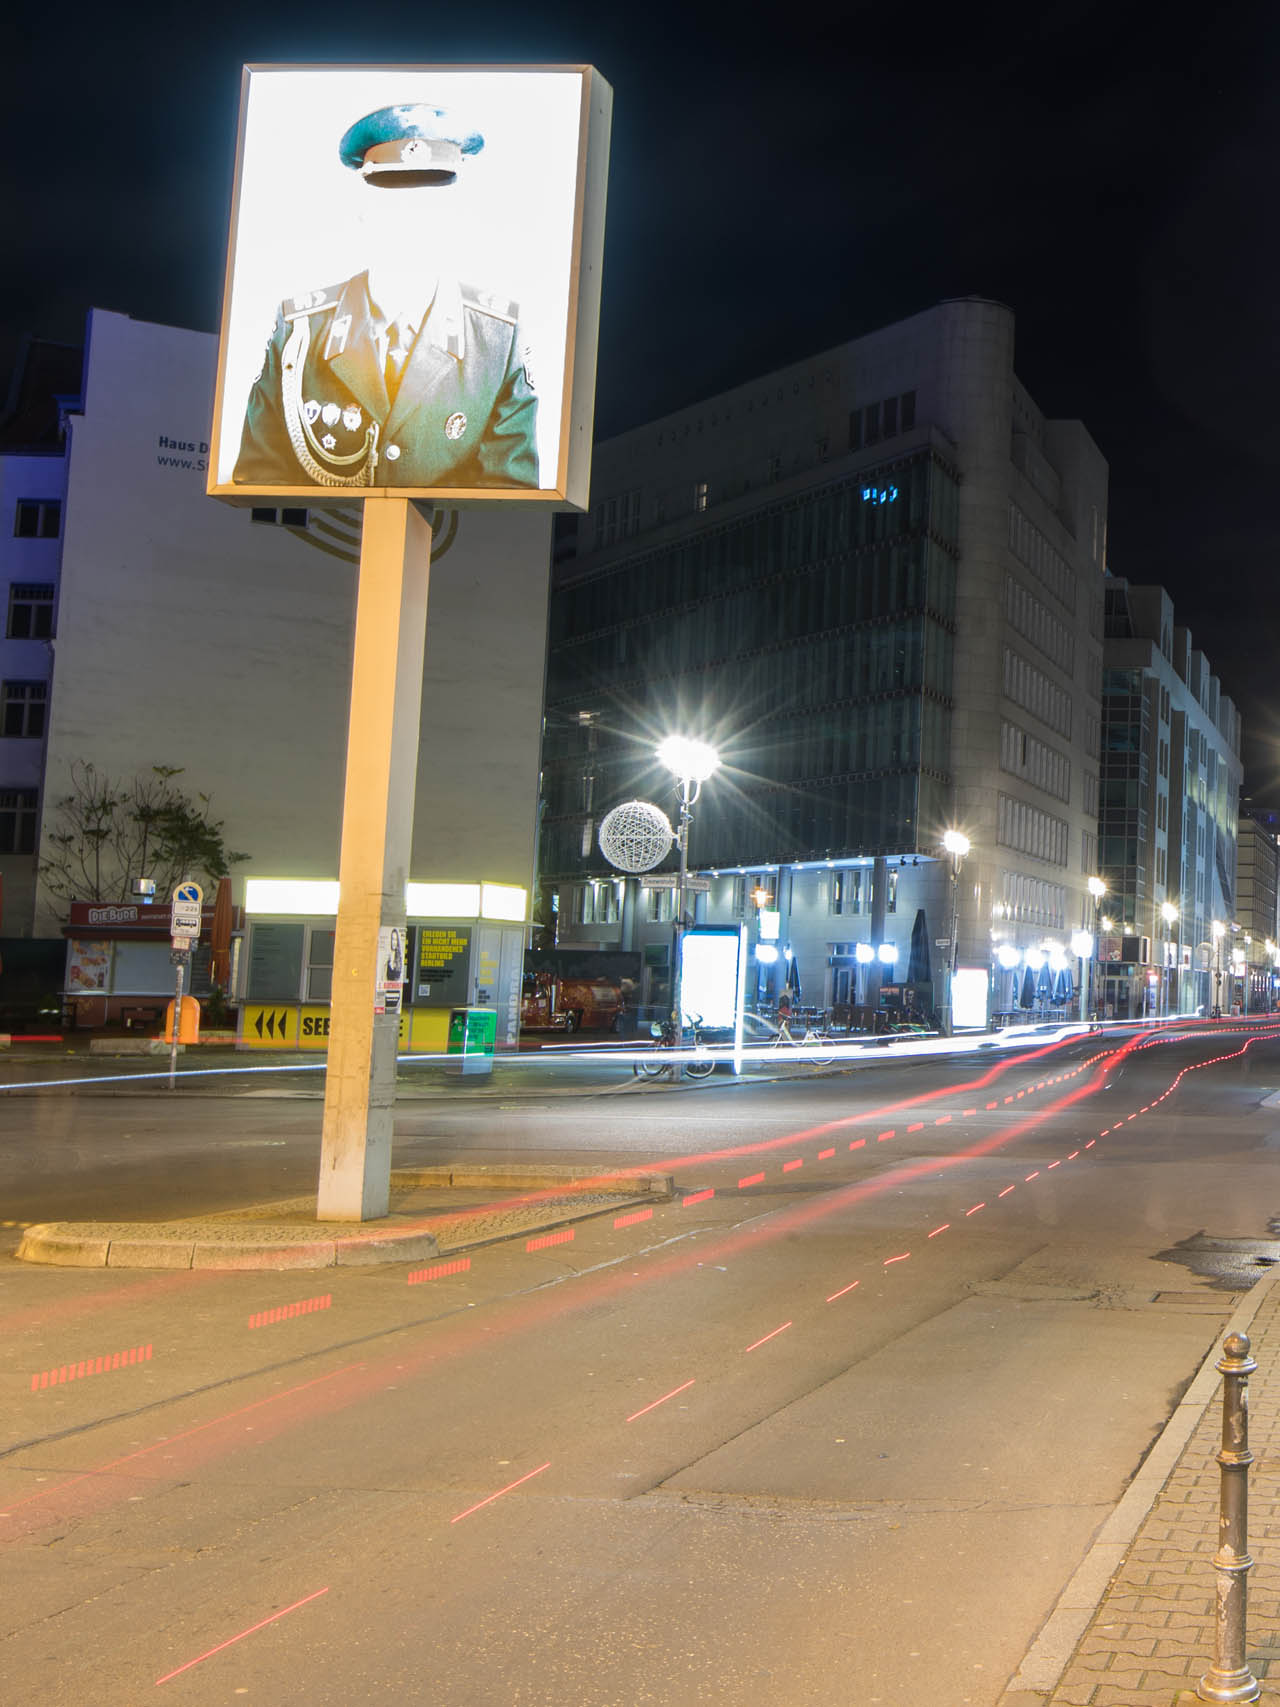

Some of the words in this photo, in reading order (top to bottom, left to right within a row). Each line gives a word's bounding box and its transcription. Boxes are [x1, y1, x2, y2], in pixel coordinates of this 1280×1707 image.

[159, 436, 195, 451] Haus
[199, 441, 209, 454] D
[157, 455, 209, 472] www.S
